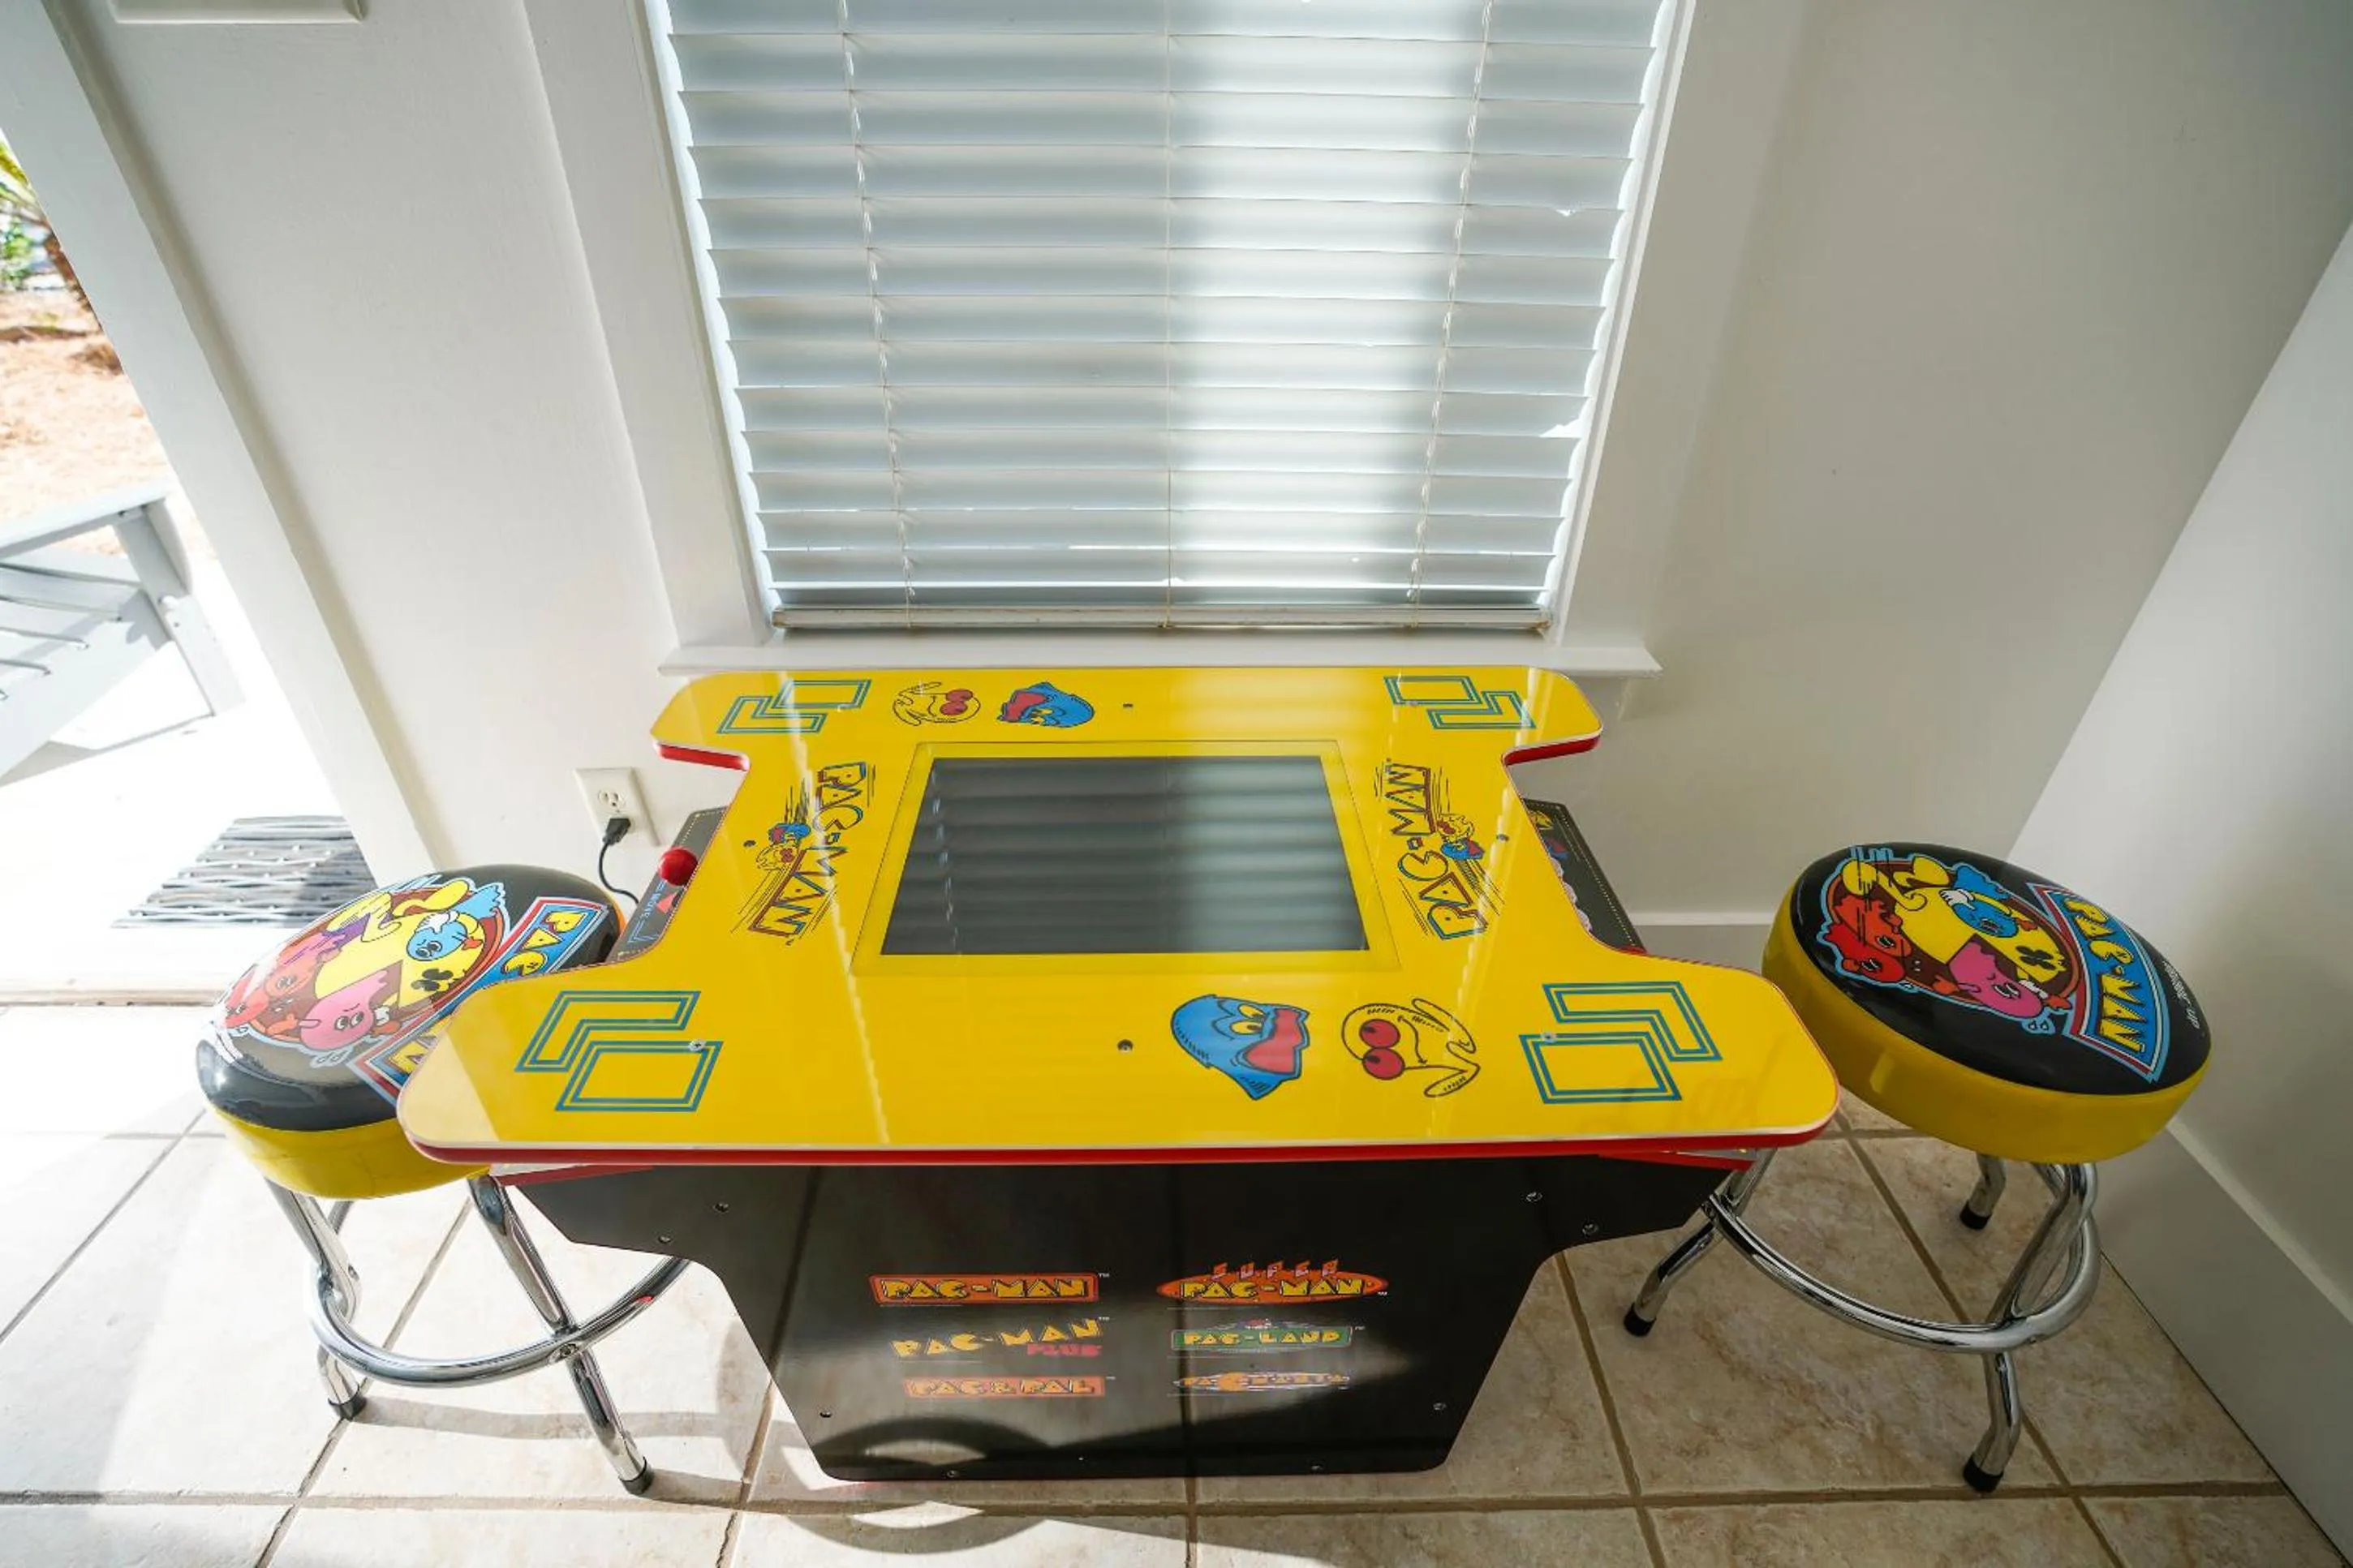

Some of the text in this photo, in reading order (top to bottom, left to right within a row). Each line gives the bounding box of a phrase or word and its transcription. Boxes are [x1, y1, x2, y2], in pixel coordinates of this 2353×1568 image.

[1210, 1258, 1339, 1281] SUPER
[880, 1278, 1089, 1298] PAC-MAN
[1181, 1278, 1366, 1299] PAC-MAN
[890, 1318, 1102, 1358] PAC-MAN
[1184, 1330, 1340, 1345] PAC-LAND
